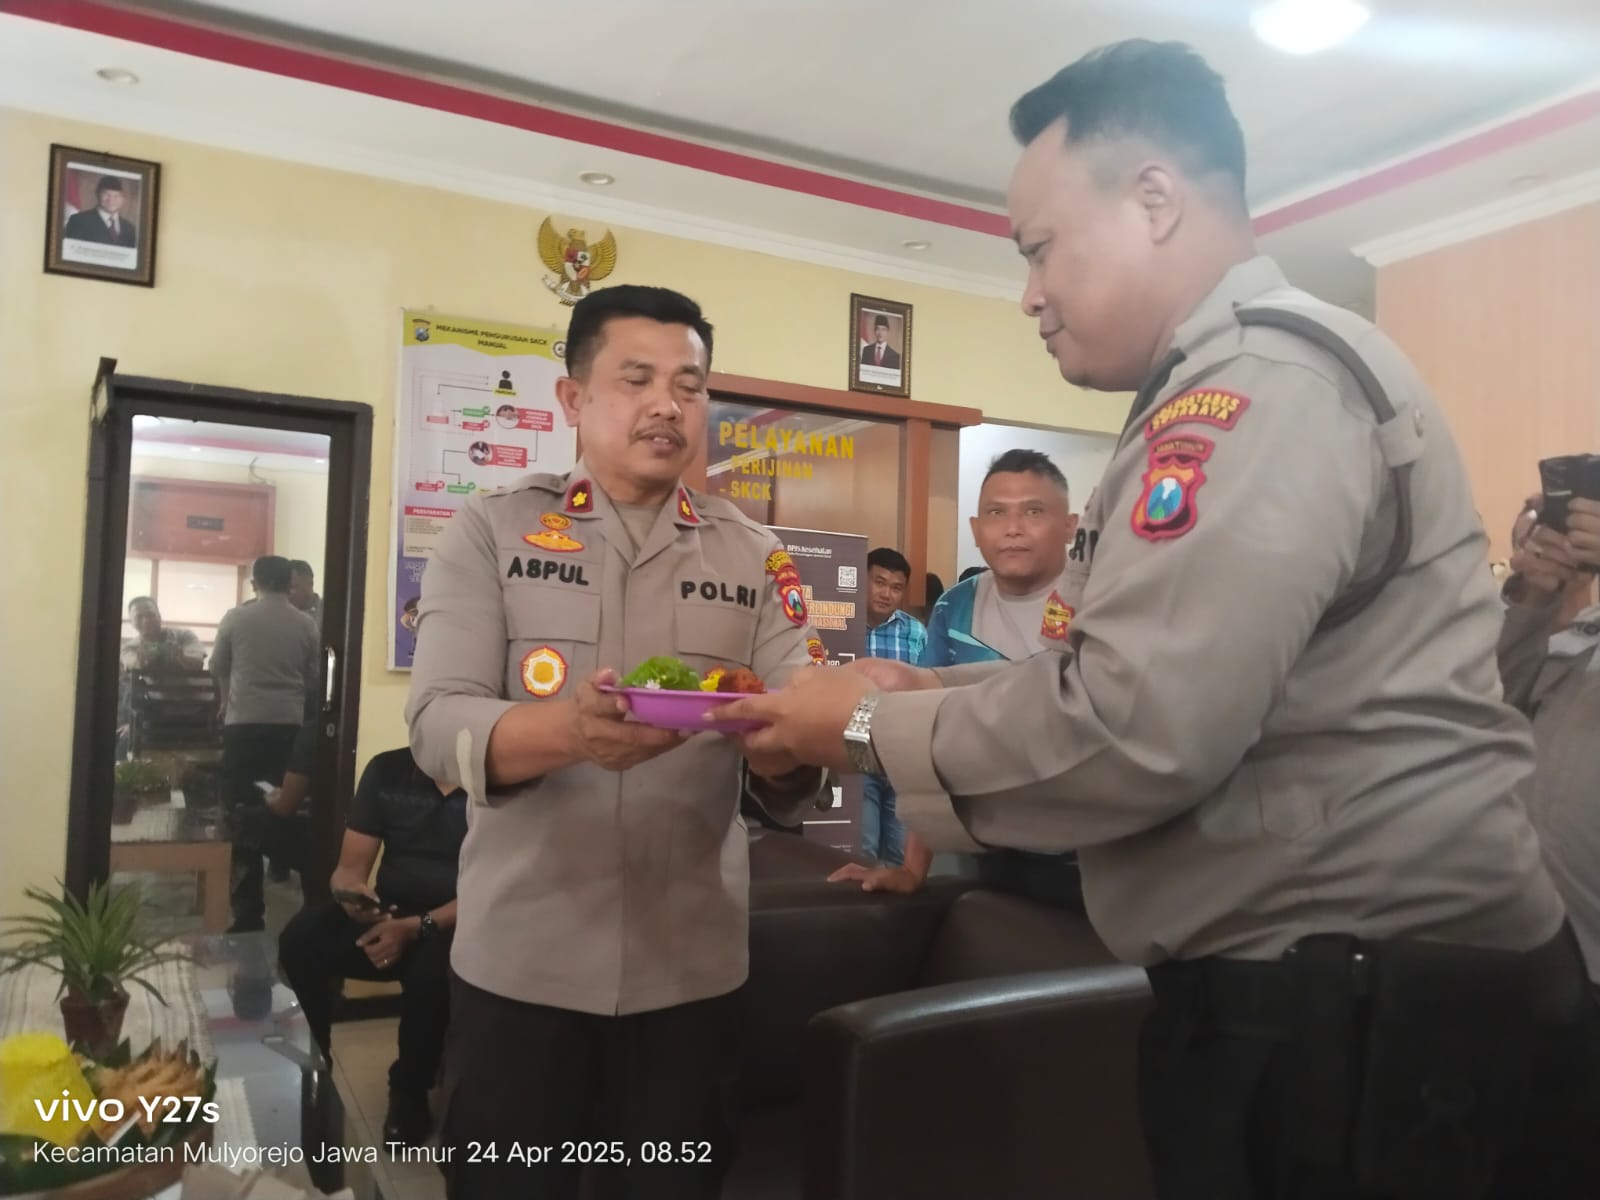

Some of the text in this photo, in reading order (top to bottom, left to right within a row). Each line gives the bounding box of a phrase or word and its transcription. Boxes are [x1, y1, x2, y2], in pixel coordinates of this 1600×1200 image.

[719, 421, 855, 459] PELAYANAN
[731, 455, 813, 480] PERIJINAN
[731, 480, 772, 501] SKCK
[681, 581, 757, 609] POLRI
